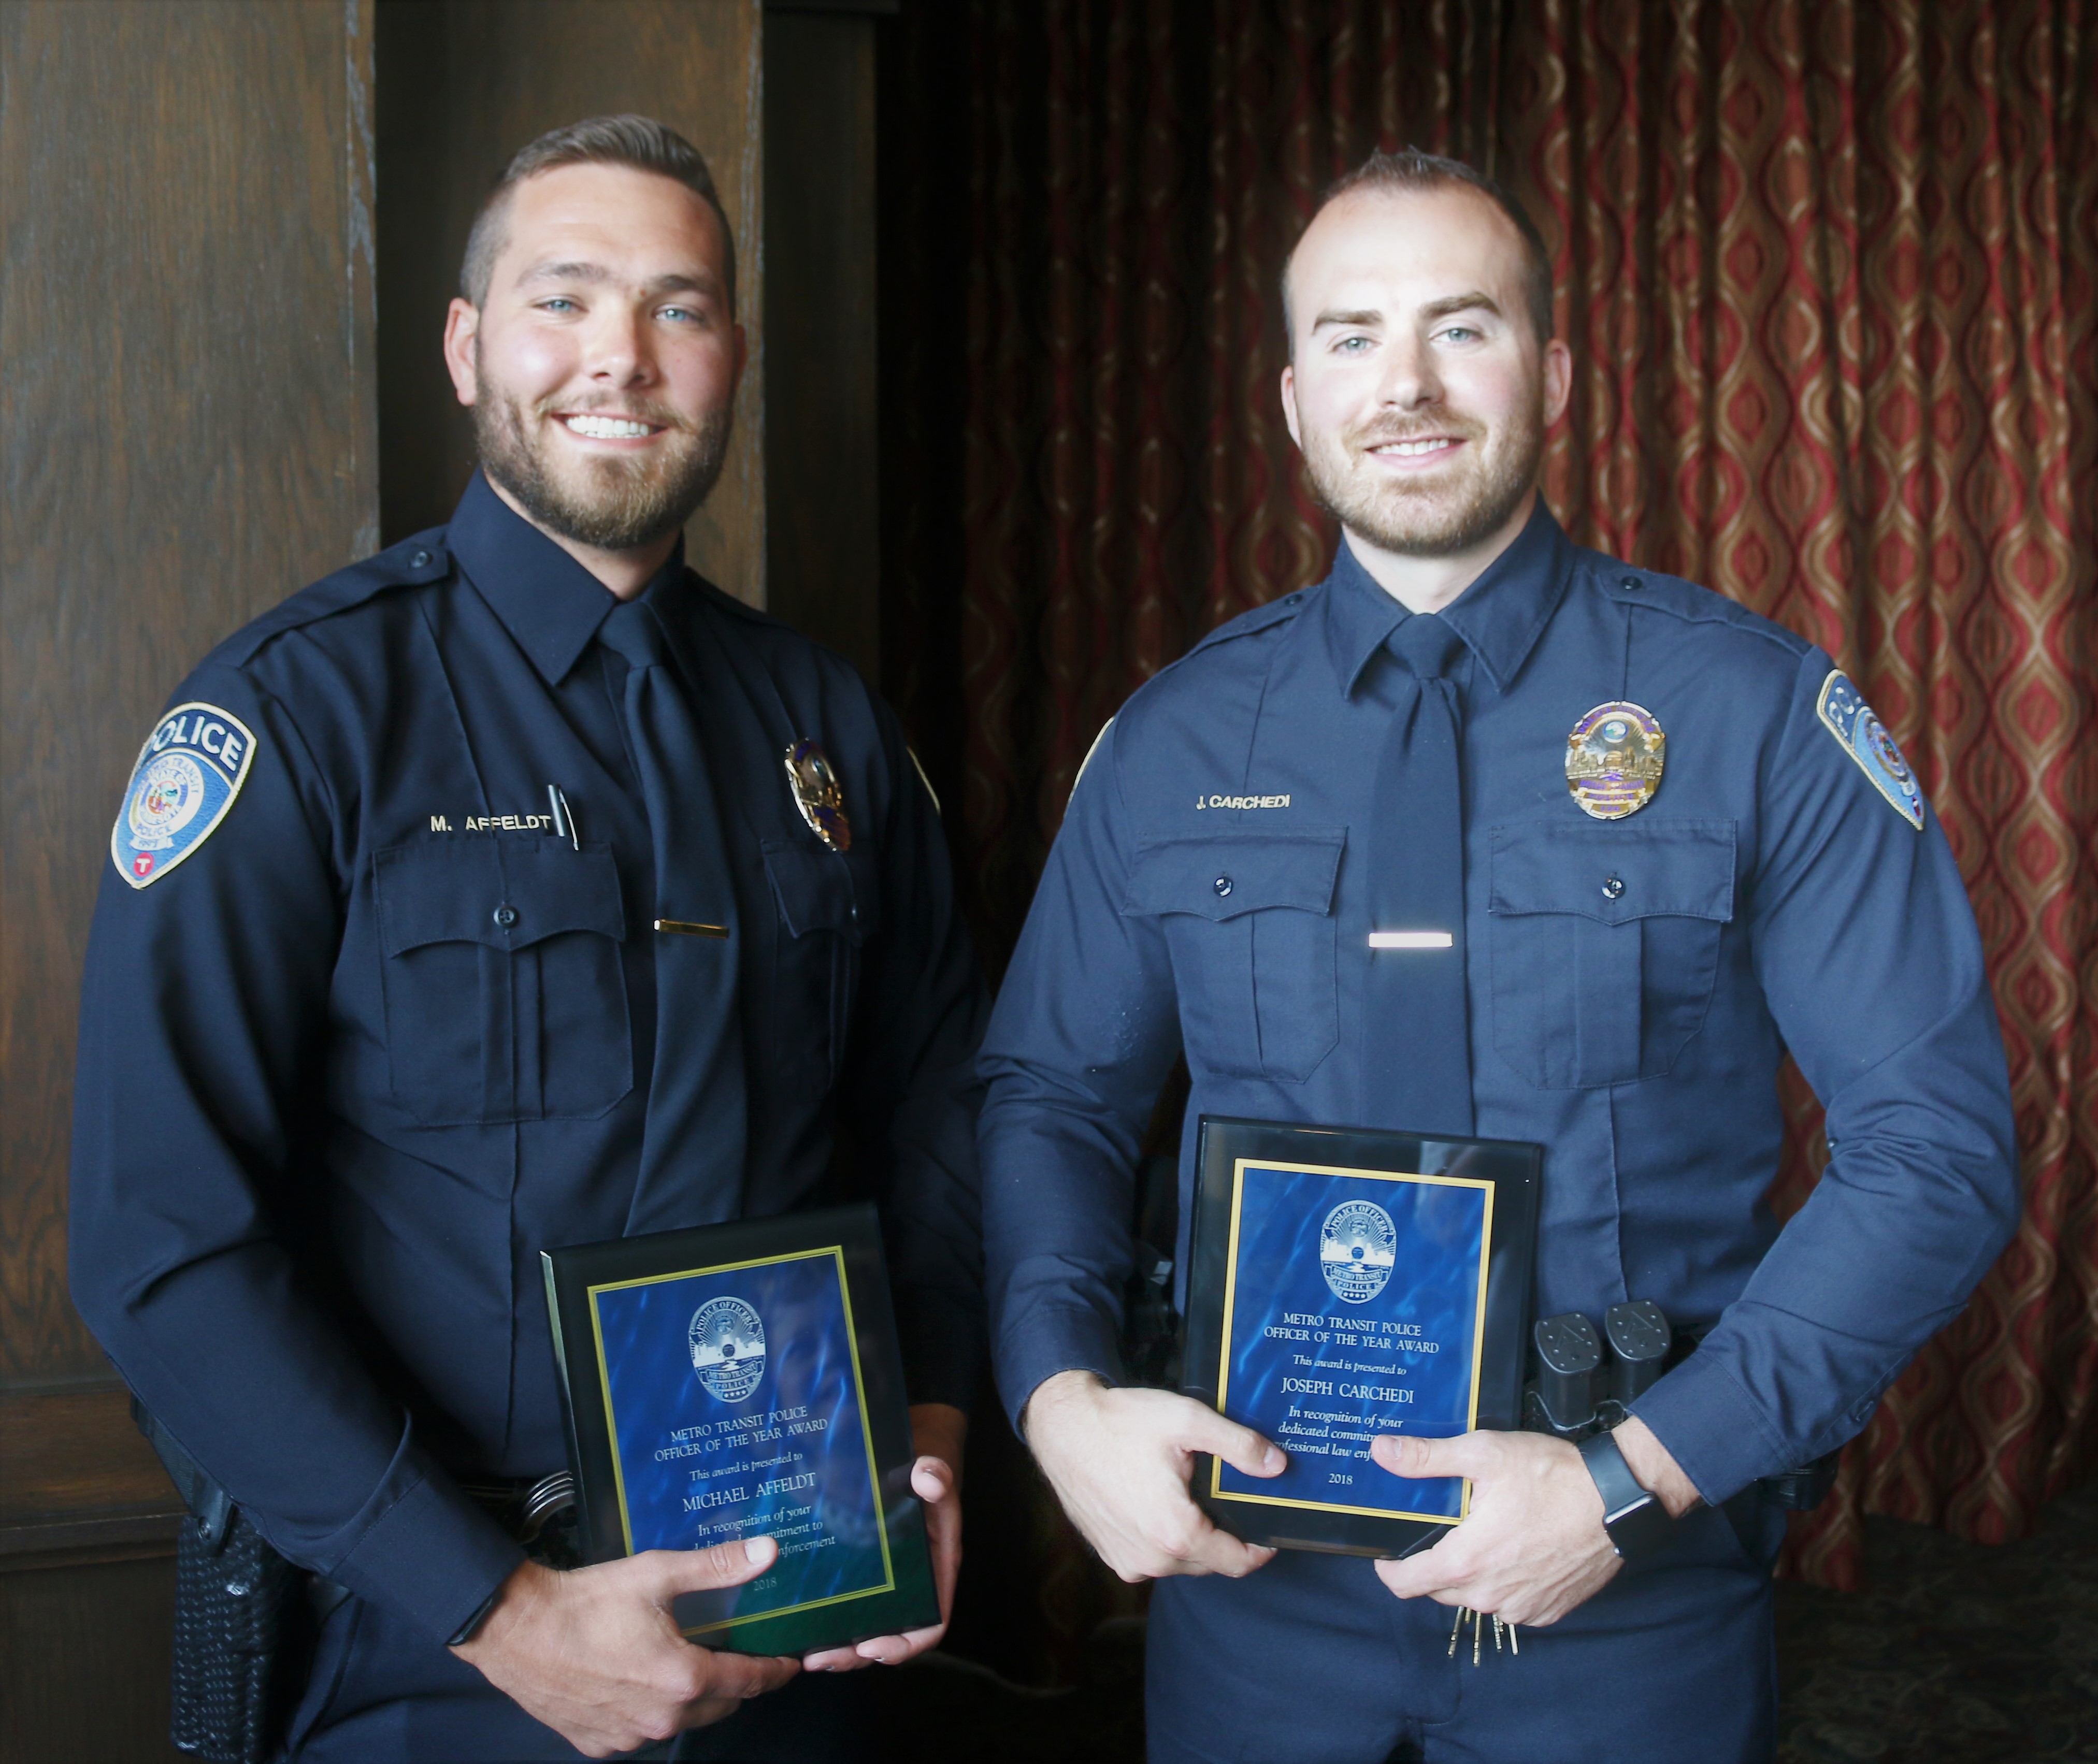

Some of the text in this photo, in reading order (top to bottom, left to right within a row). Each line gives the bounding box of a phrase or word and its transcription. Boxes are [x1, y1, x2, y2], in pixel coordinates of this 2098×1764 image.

[152, 716, 242, 771] OLICE
[1209, 794, 1290, 809] CARCHEDI
[430, 815, 551, 832] M. AFFELDT
[1331, 1205, 1388, 1231] POLICE OFFICER
[1337, 1280, 1372, 1289] POLICE
[1284, 1312, 1421, 1336] METRO TRANSIT POLICE
[1263, 1326, 1439, 1354] OFFICER OF THE YEAR AWARD
[1292, 1354, 1406, 1376] This award is presented to
[715, 1379, 750, 1389] POLICE
[1281, 1377, 1414, 1404] JOSEPH CARCHEDI
[670, 1406, 808, 1442] METRO TRANSIT POLICE
[1288, 1406, 1403, 1428] In recognition of your
[654, 1419, 828, 1462] OFFICER OF THE YEAR AWARD
[1278, 1422, 1376, 1442] dedicated commit
[1275, 1439, 1329, 1455] rofessional
[1332, 1443, 1351, 1457] law
[689, 1452, 802, 1481] This award is presented to
[1329, 1473, 1353, 1485] 2018
[683, 1472, 816, 1512] MICHAEL AFFELDT
[698, 1505, 812, 1536] In recognition of your
[812, 1521, 823, 1530] to
[779, 1536, 836, 1557] nforcement
[754, 1577, 777, 1591] 2018
